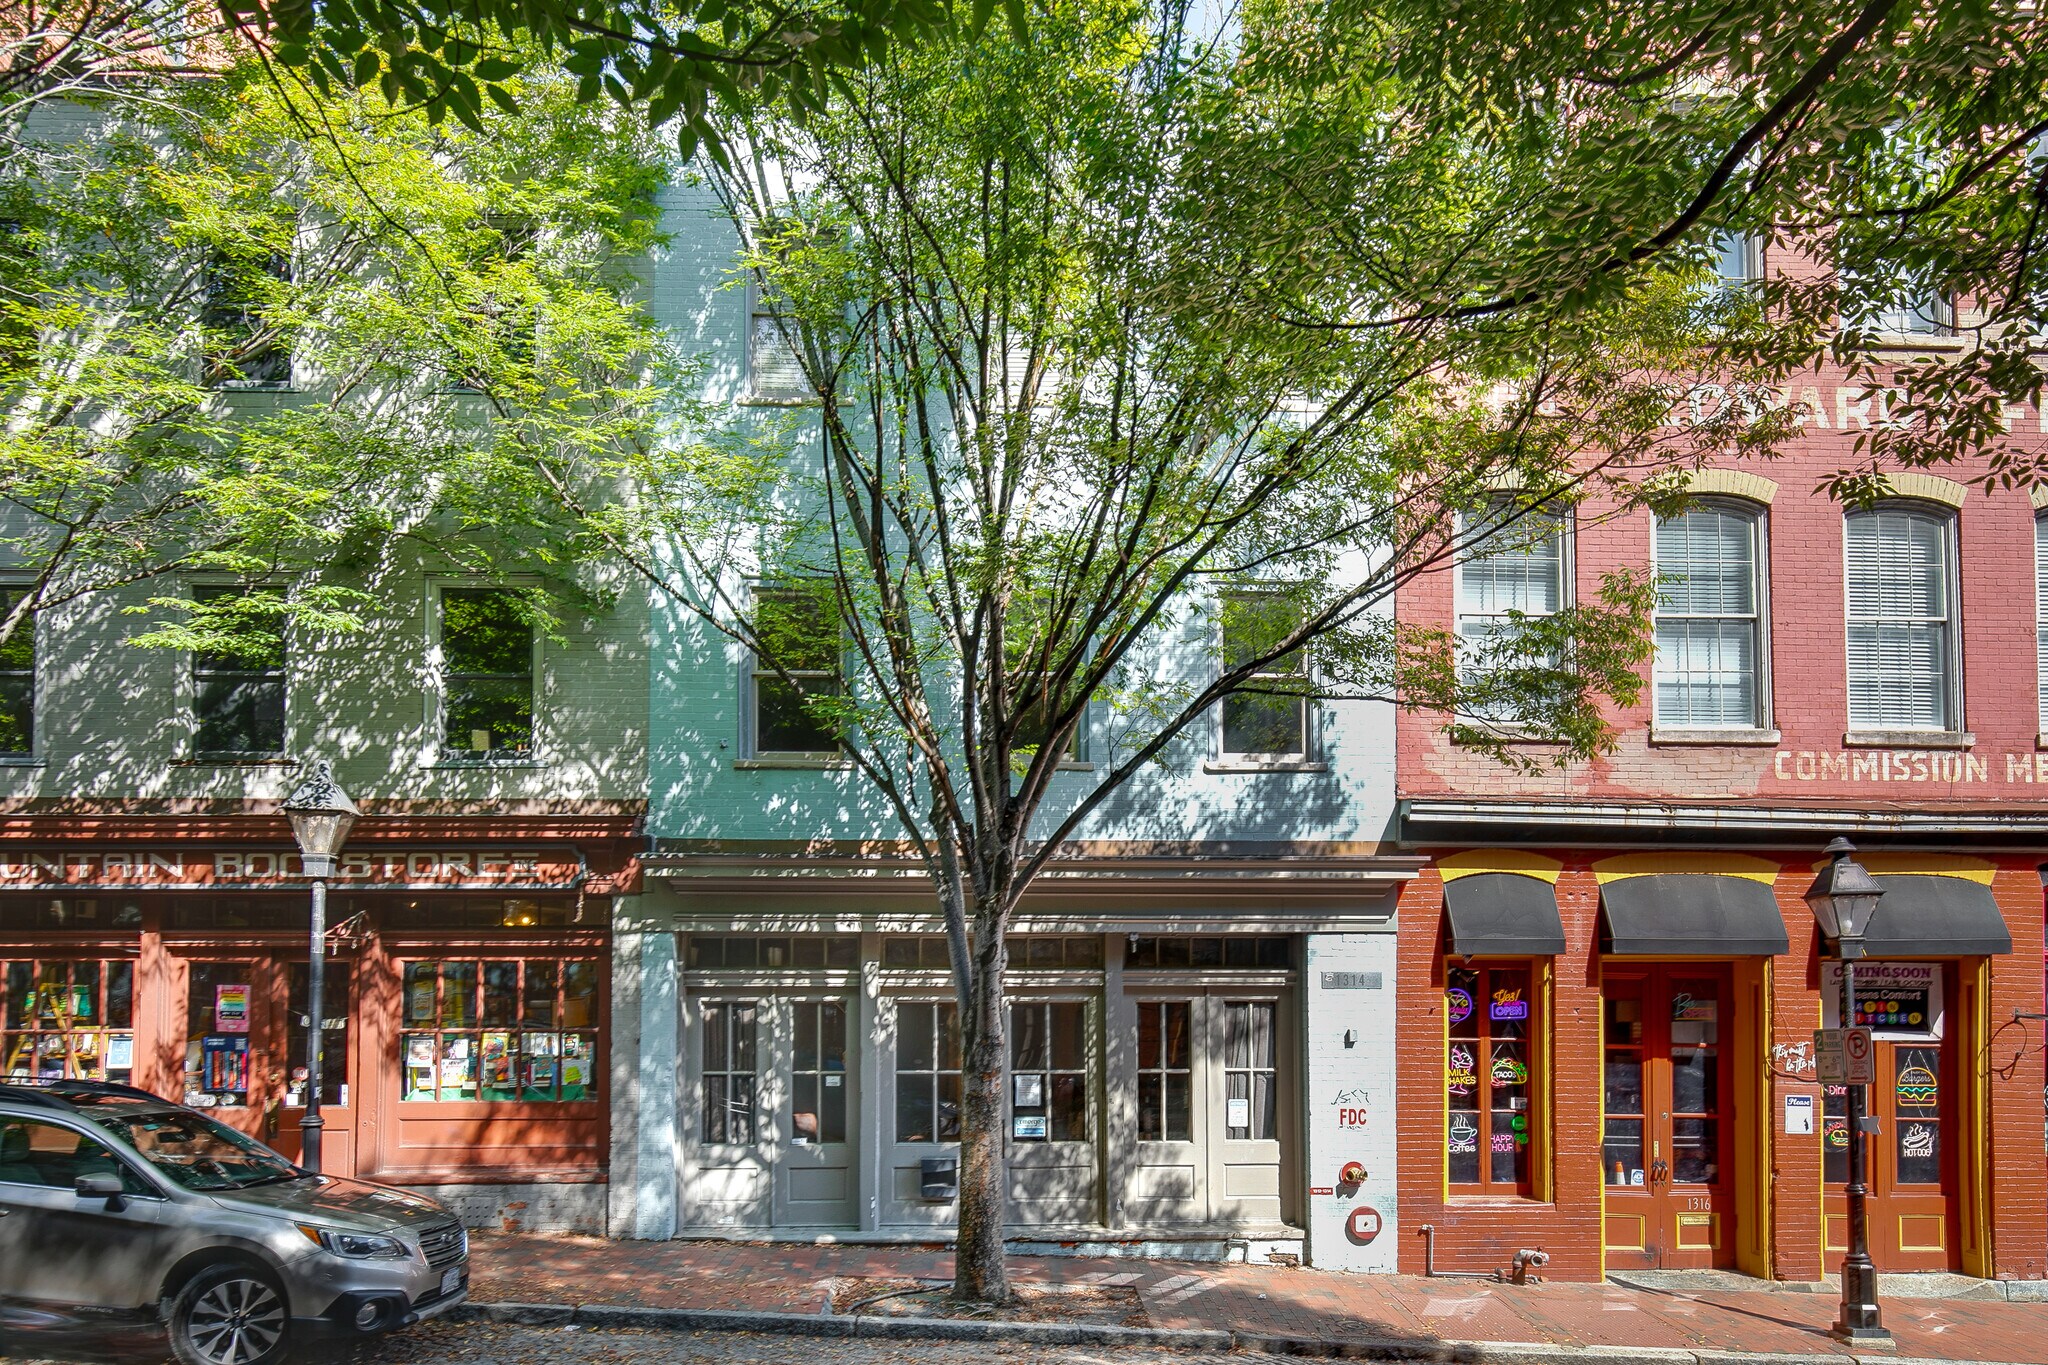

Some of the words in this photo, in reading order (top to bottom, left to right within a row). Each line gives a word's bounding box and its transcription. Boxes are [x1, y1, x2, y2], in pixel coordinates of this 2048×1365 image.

[1774, 750, 1987, 783] COMMISSION
[0, 852, 183, 879] UNTAIN
[214, 852, 509, 878] BOOSTORE
[1833, 966, 1890, 978] CMING
[1336, 974, 1365, 987] 1314
[1493, 988, 1521, 1005] Yes!
[1841, 991, 1880, 1000] eens
[1880, 990, 1922, 1000] Comfort
[1495, 1006, 1522, 1016] OPEN
[1854, 1014, 1920, 1023] ITCHEN
[1815, 1035, 1822, 1049] 2
[1448, 1069, 1470, 1077] MILK
[1448, 1076, 1476, 1085] HAKES
[1787, 1098, 1810, 1106] Please
[1339, 1108, 1367, 1125] FDC
[1448, 1143, 1476, 1152] Coffee
[1491, 1143, 1514, 1152] HOUR
[1687, 1197, 1711, 1210] 1316
